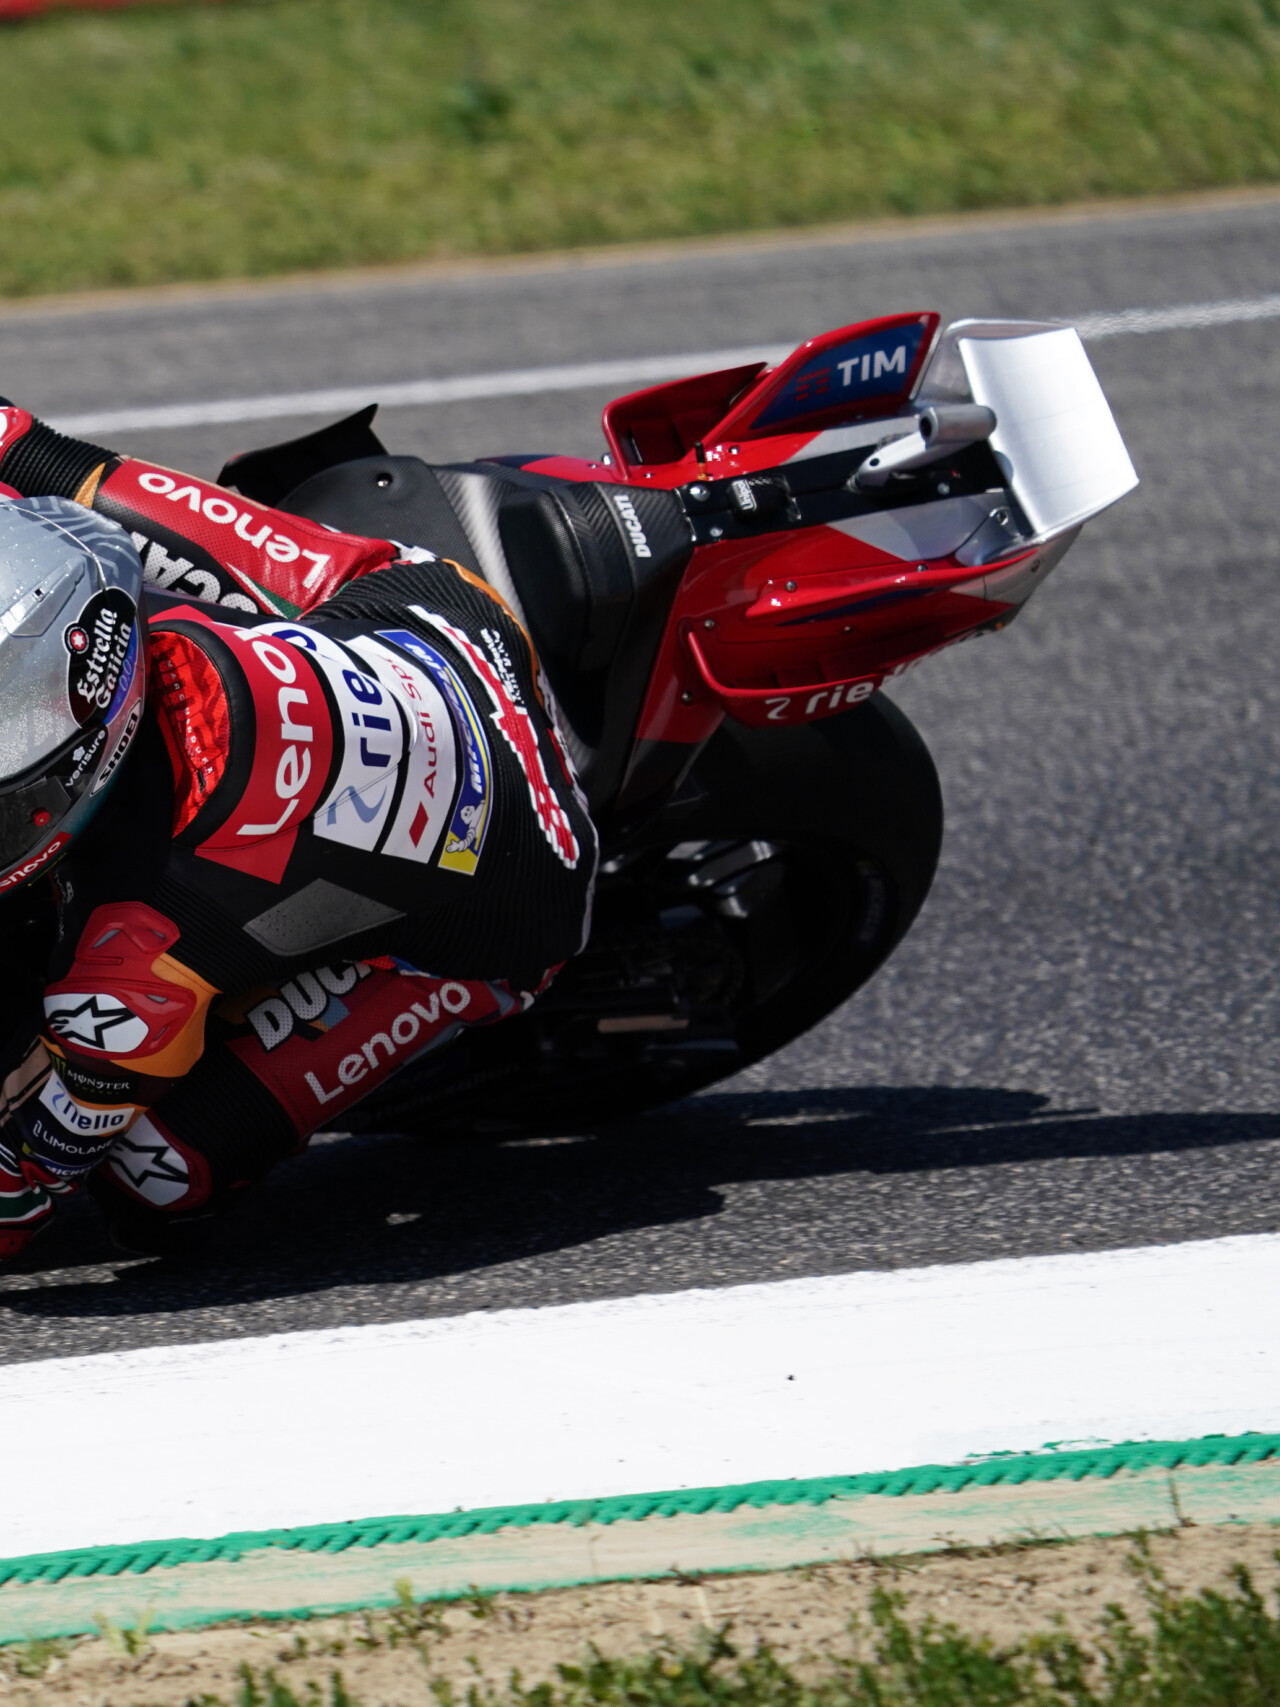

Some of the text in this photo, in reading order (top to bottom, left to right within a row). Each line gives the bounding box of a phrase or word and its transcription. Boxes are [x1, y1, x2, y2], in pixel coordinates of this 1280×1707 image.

[836, 346, 907, 387] TIM
[138, 472, 332, 590] Lenovo
[613, 493, 652, 558] DUCATI
[77, 607, 118, 703] Estrella
[95, 622, 132, 709] Galicia
[66, 730, 106, 787] verisure
[99, 712, 138, 783] SHOEI
[236, 628, 315, 836] Leno
[416, 711, 438, 799] Audi
[246, 960, 368, 1051] DUC
[304, 981, 471, 1104] Lenovo
[67, 1069, 130, 1089] MONSTER
[43, 1131, 114, 1155] LIMOLAN
